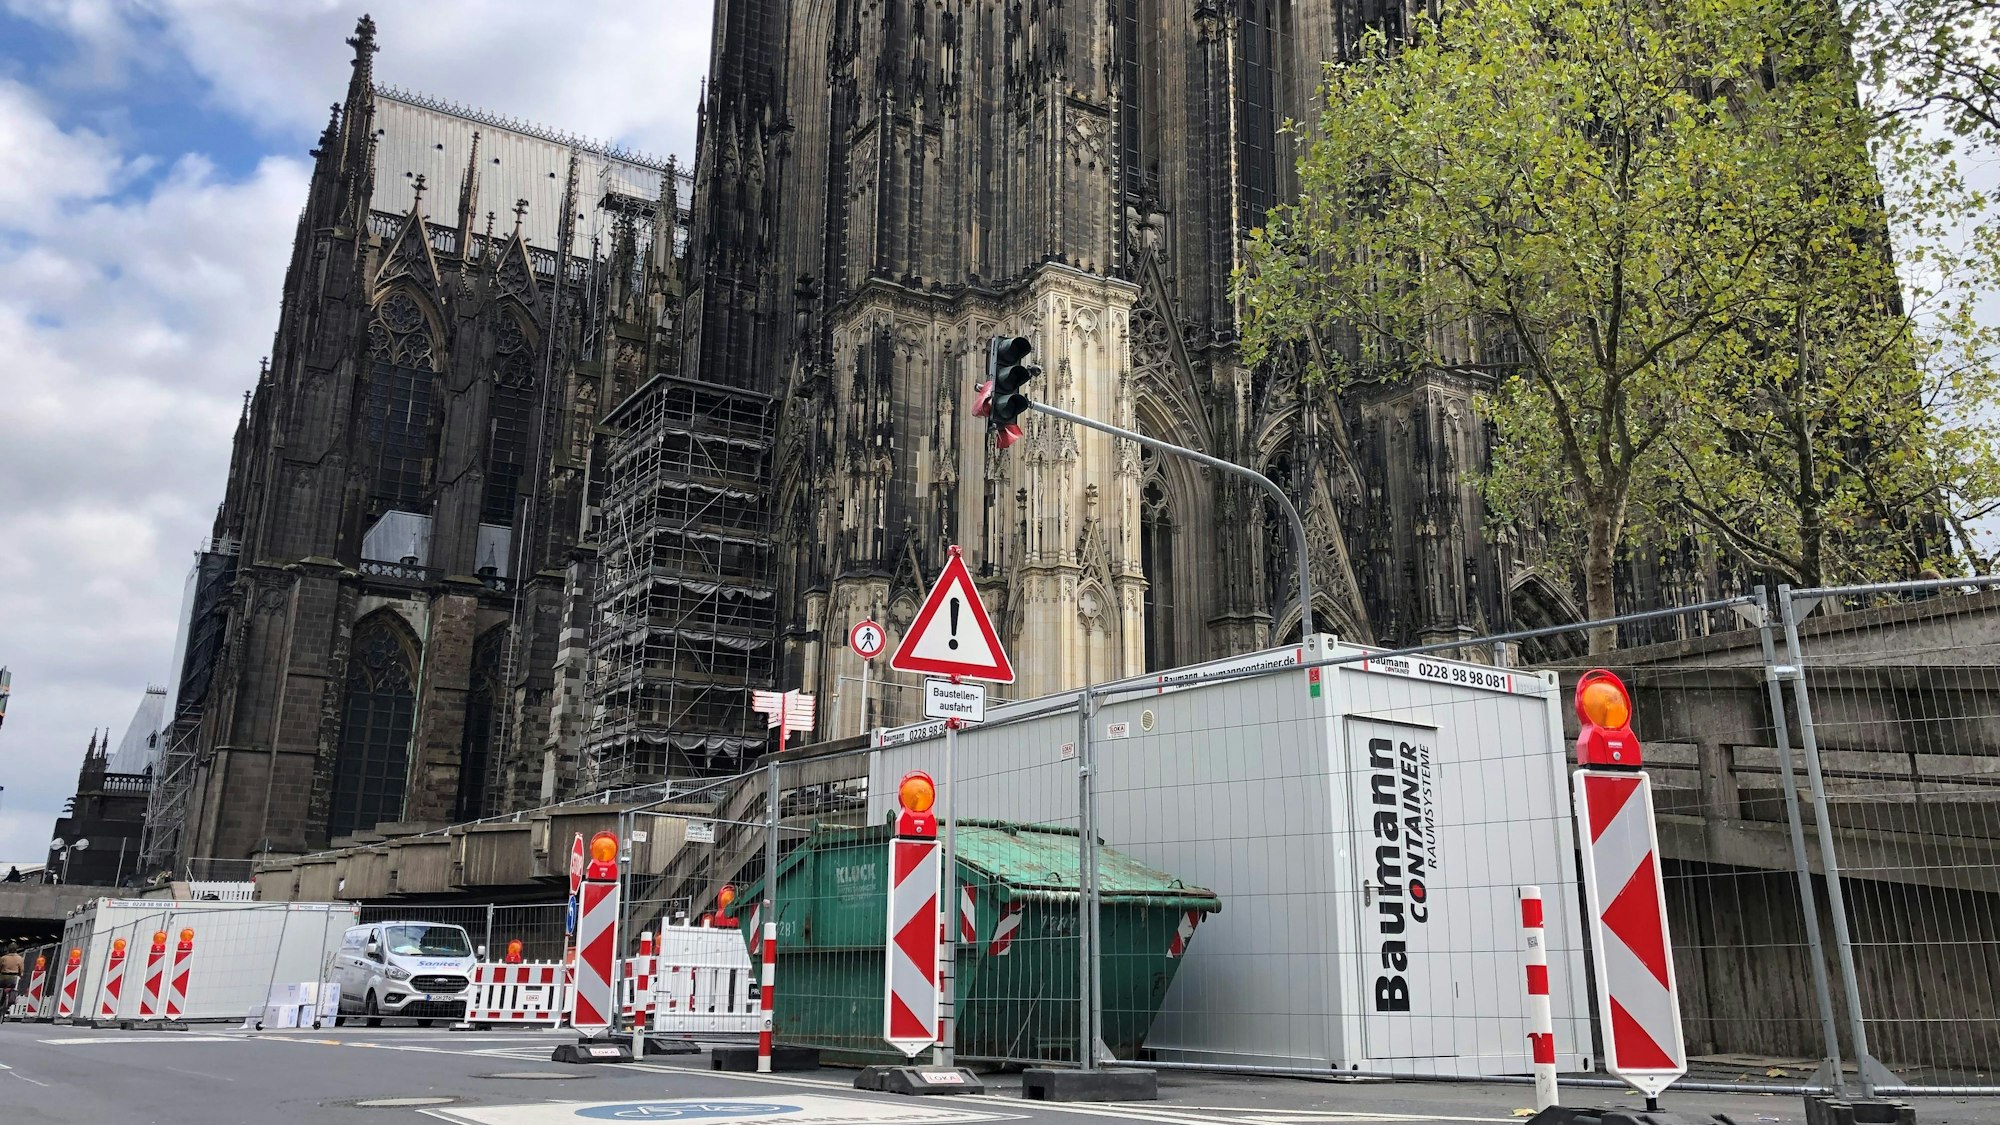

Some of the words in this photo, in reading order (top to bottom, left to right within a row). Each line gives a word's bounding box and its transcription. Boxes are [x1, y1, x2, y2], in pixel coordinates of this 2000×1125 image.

[1418, 663, 1449, 680] 0228
[1452, 668, 1467, 683] 98
[1469, 670, 1484, 686] 98
[1485, 673, 1506, 689] 081
[933, 688, 979, 700] Baustellen-
[939, 702, 973, 713] ausfahrt
[909, 728, 927, 741] 0228
[929, 725, 938, 737] 98
[1419, 743, 1437, 869] RAUMSYSTEME
[1400, 741, 1428, 923] CONTAINER
[1368, 738, 1410, 1012] Baumann
